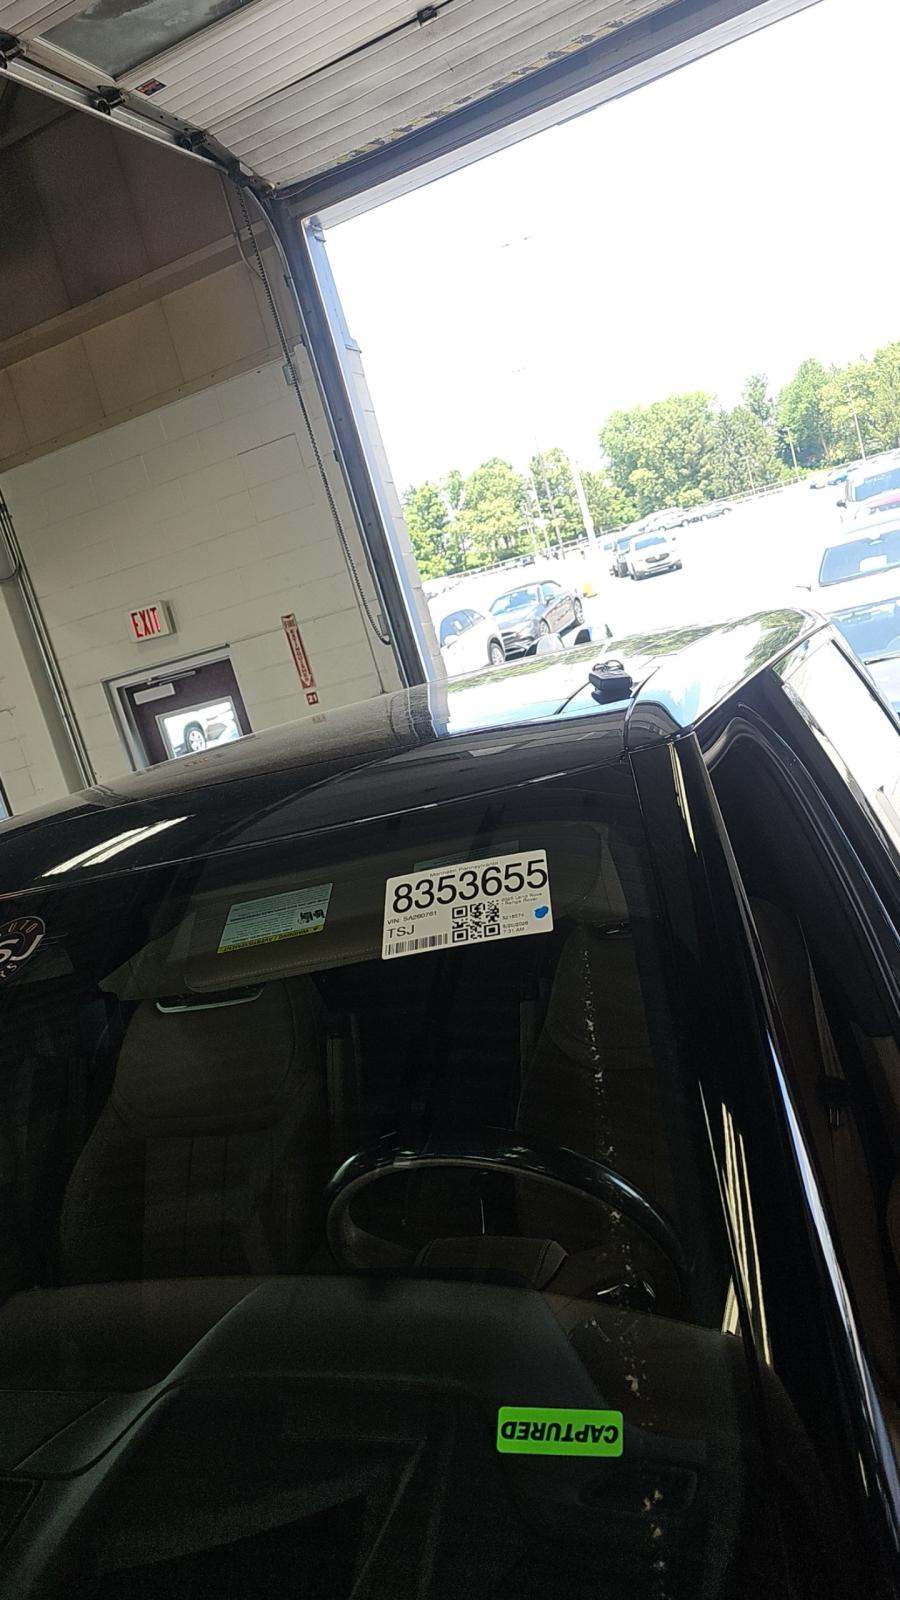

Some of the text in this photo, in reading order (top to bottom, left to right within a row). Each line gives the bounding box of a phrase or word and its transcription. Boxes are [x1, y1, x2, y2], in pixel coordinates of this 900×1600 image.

[131, 607, 160, 638] EXIT
[392, 859, 548, 914] 8353655
[386, 925, 415, 939] TSJ
[501, 1421, 619, 1444] CAPTURED
